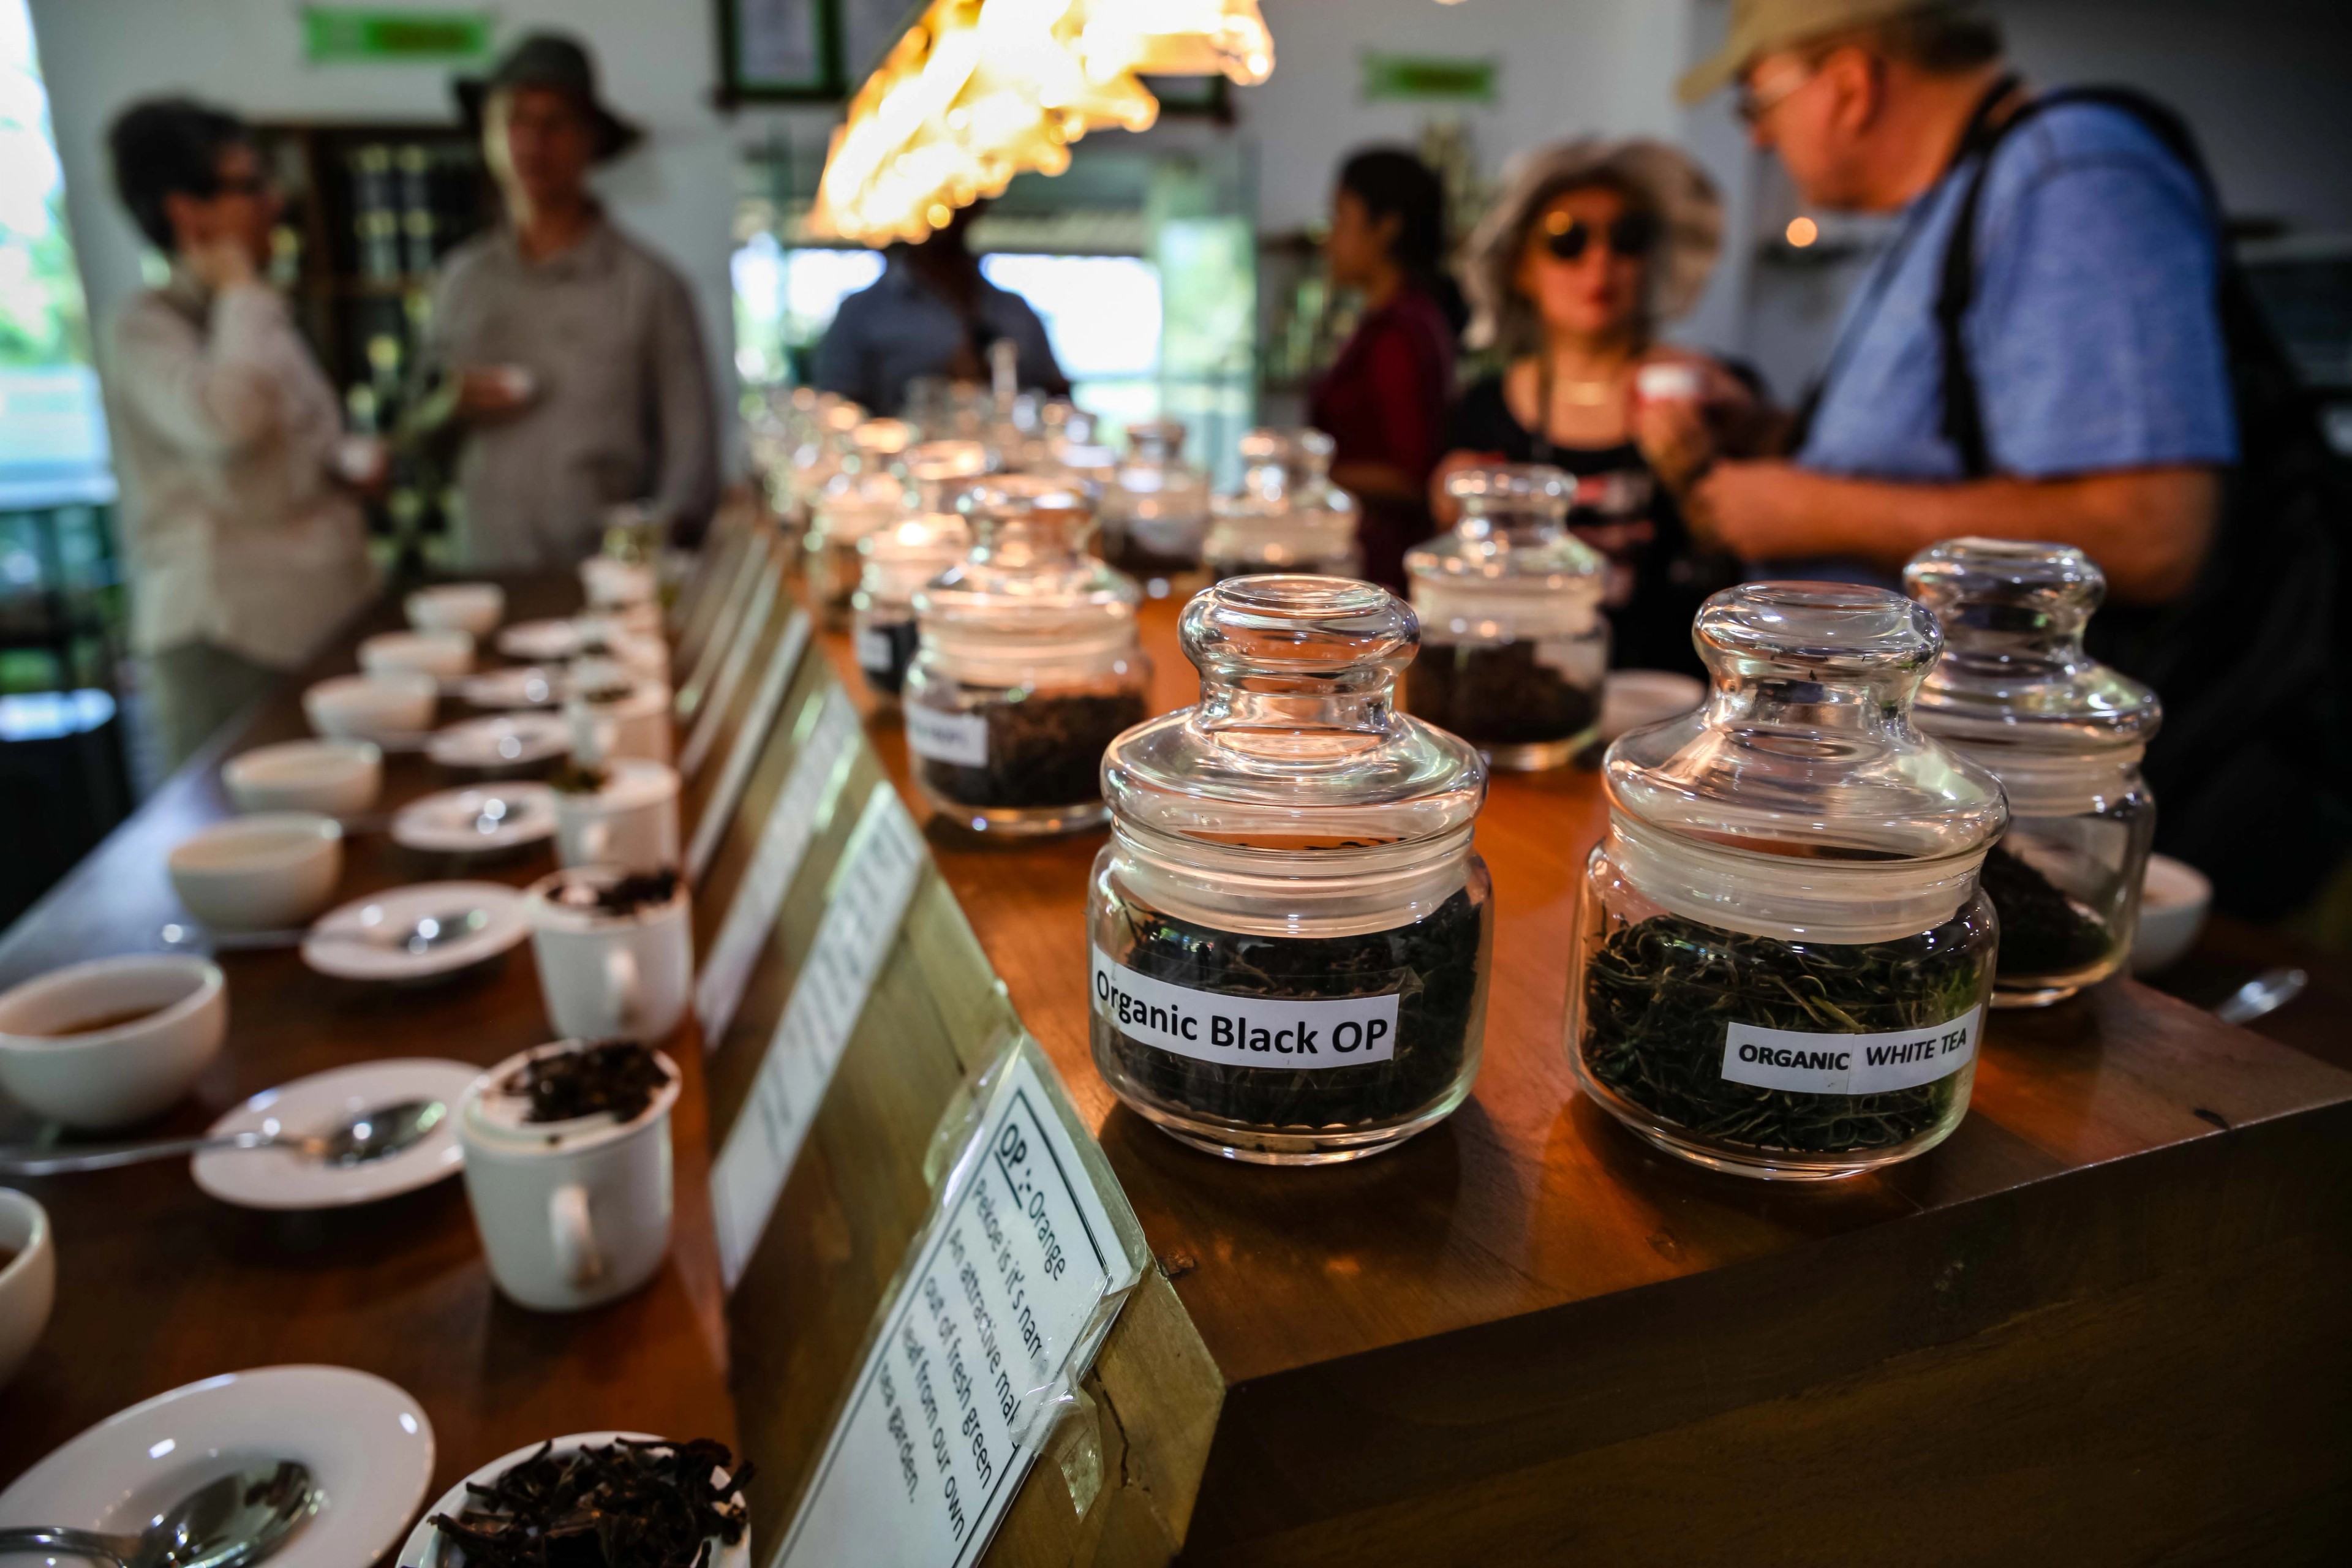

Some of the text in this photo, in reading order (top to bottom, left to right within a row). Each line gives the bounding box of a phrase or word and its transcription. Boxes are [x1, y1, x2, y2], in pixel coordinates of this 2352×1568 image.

[1096, 970, 1389, 1055] Organic Black OP
[1739, 1027, 1967, 1071] ORGANIC WHITE TEA
[973, 1177, 1003, 1253] Pekoe
[998, 1240, 1012, 1273] is
[1029, 1191, 1066, 1281] Orange
[948, 1228, 965, 1266] An
[960, 1262, 1001, 1374] attractive
[924, 1276, 992, 1490] out of fresh green
[916, 1359, 938, 1429] from
[932, 1427, 951, 1474] our
[944, 1475, 965, 1542] own
